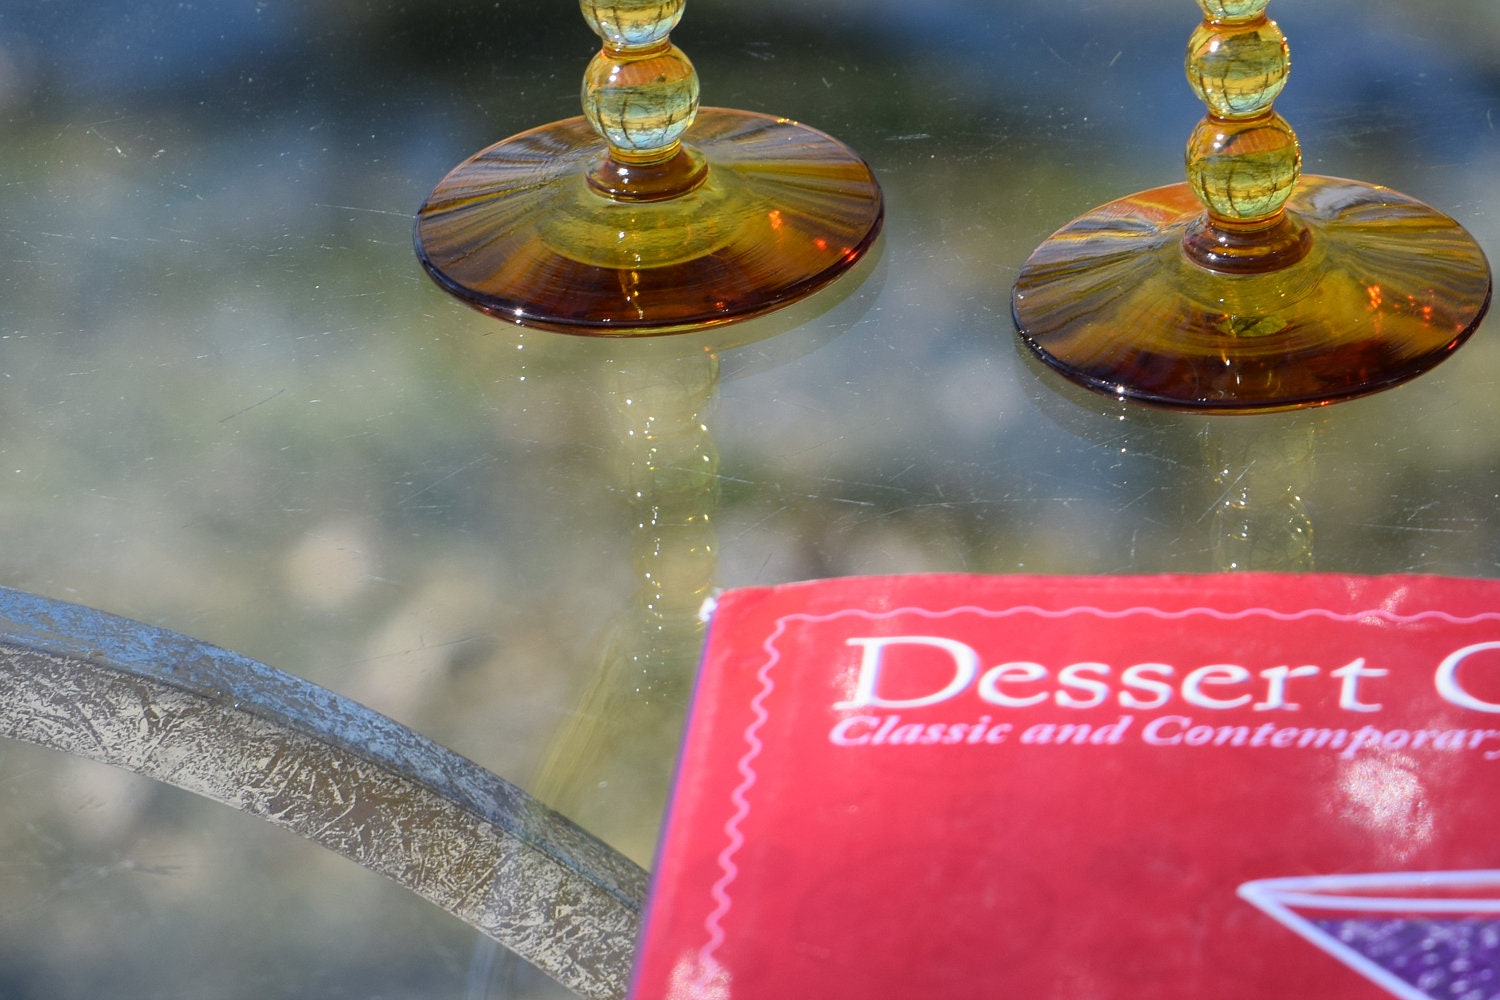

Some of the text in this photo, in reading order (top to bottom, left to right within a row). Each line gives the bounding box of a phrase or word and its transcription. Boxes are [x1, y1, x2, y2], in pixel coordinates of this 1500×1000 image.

[832, 635, 1390, 712] Dessert
[828, 714, 1012, 747] Classic
[1019, 714, 1134, 746] and
